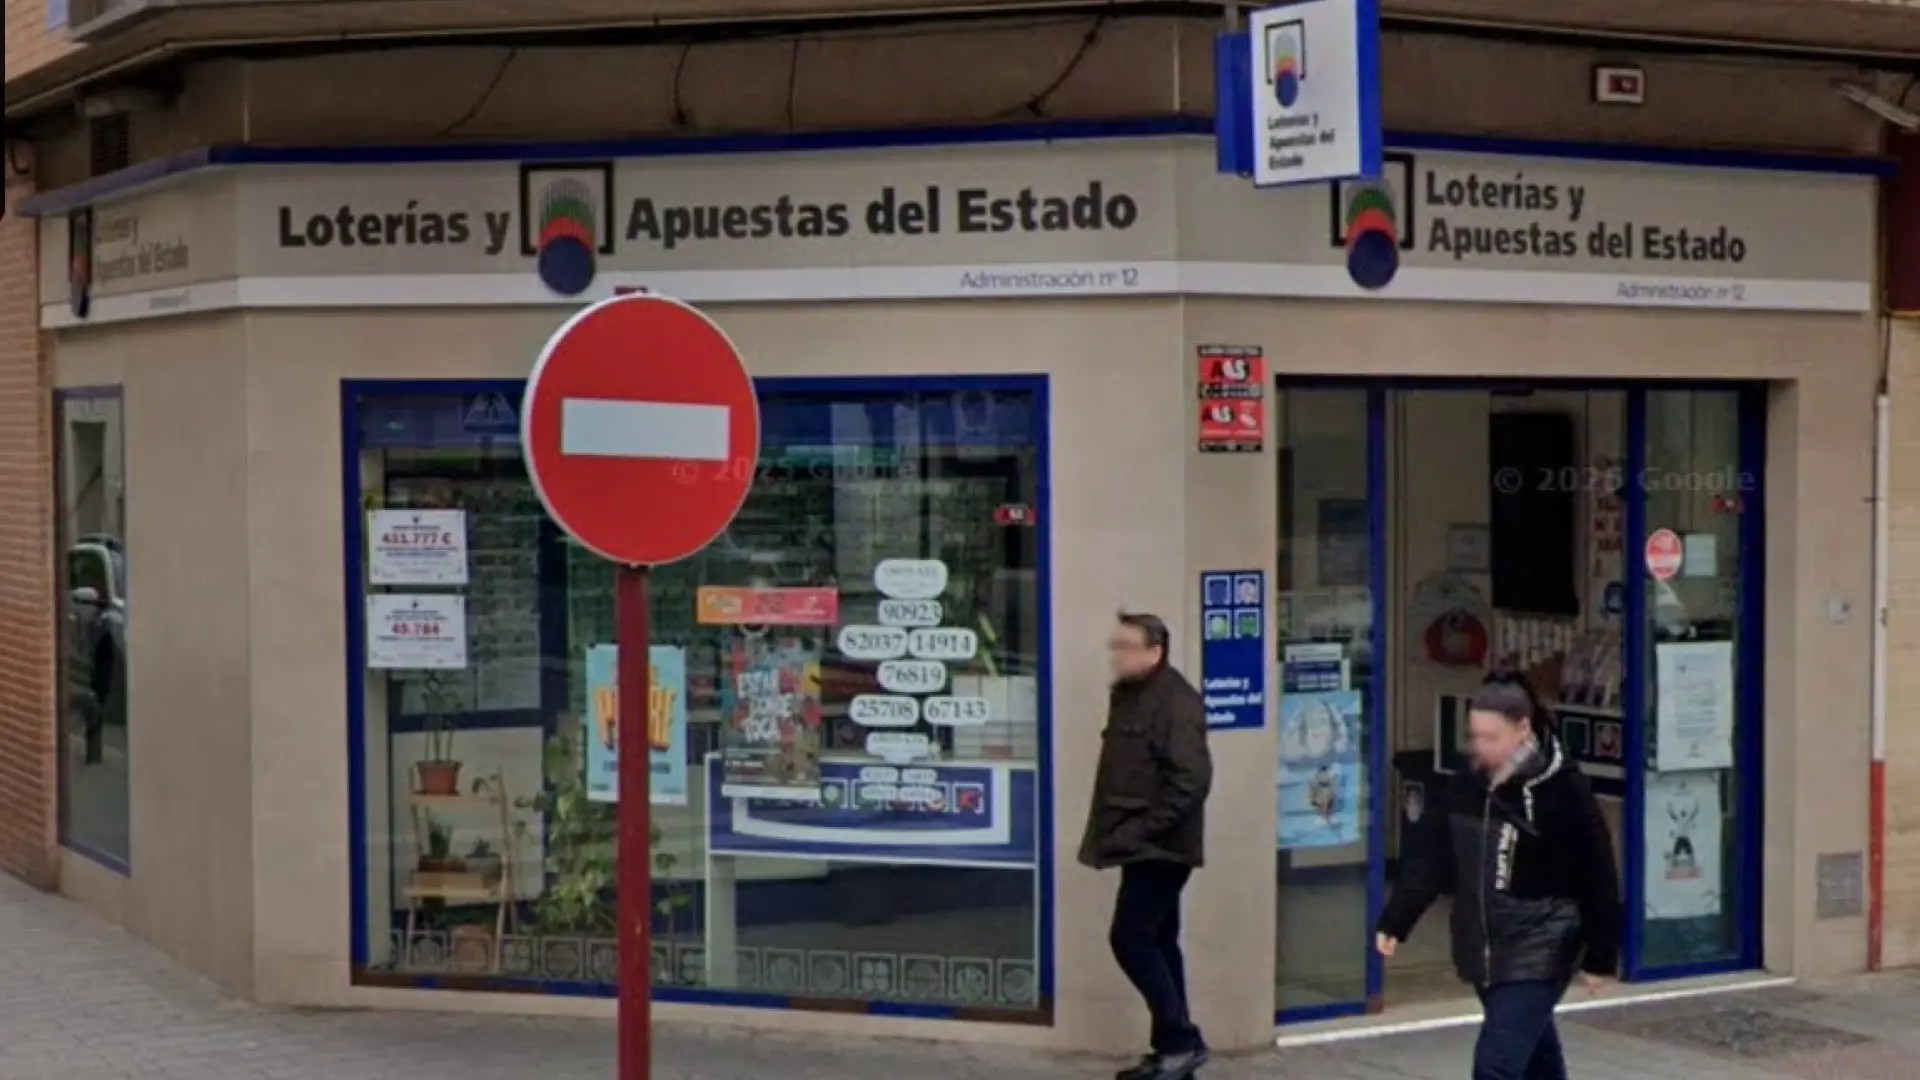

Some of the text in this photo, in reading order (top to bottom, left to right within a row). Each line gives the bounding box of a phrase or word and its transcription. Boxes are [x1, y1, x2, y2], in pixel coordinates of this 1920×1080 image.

[1425, 170, 1585, 221] Loterías y
[279, 181, 1138, 255] Loterías y Apuestas del Estado
[1427, 216, 1747, 262] Apuestas del Estado
[960, 270, 1095, 290] Administración
[1121, 267, 1139, 286] 12
[884, 603, 942, 621] 90923
[846, 632, 904, 651] 82037
[884, 664, 942, 684] 76819
[927, 701, 987, 718] 67143
